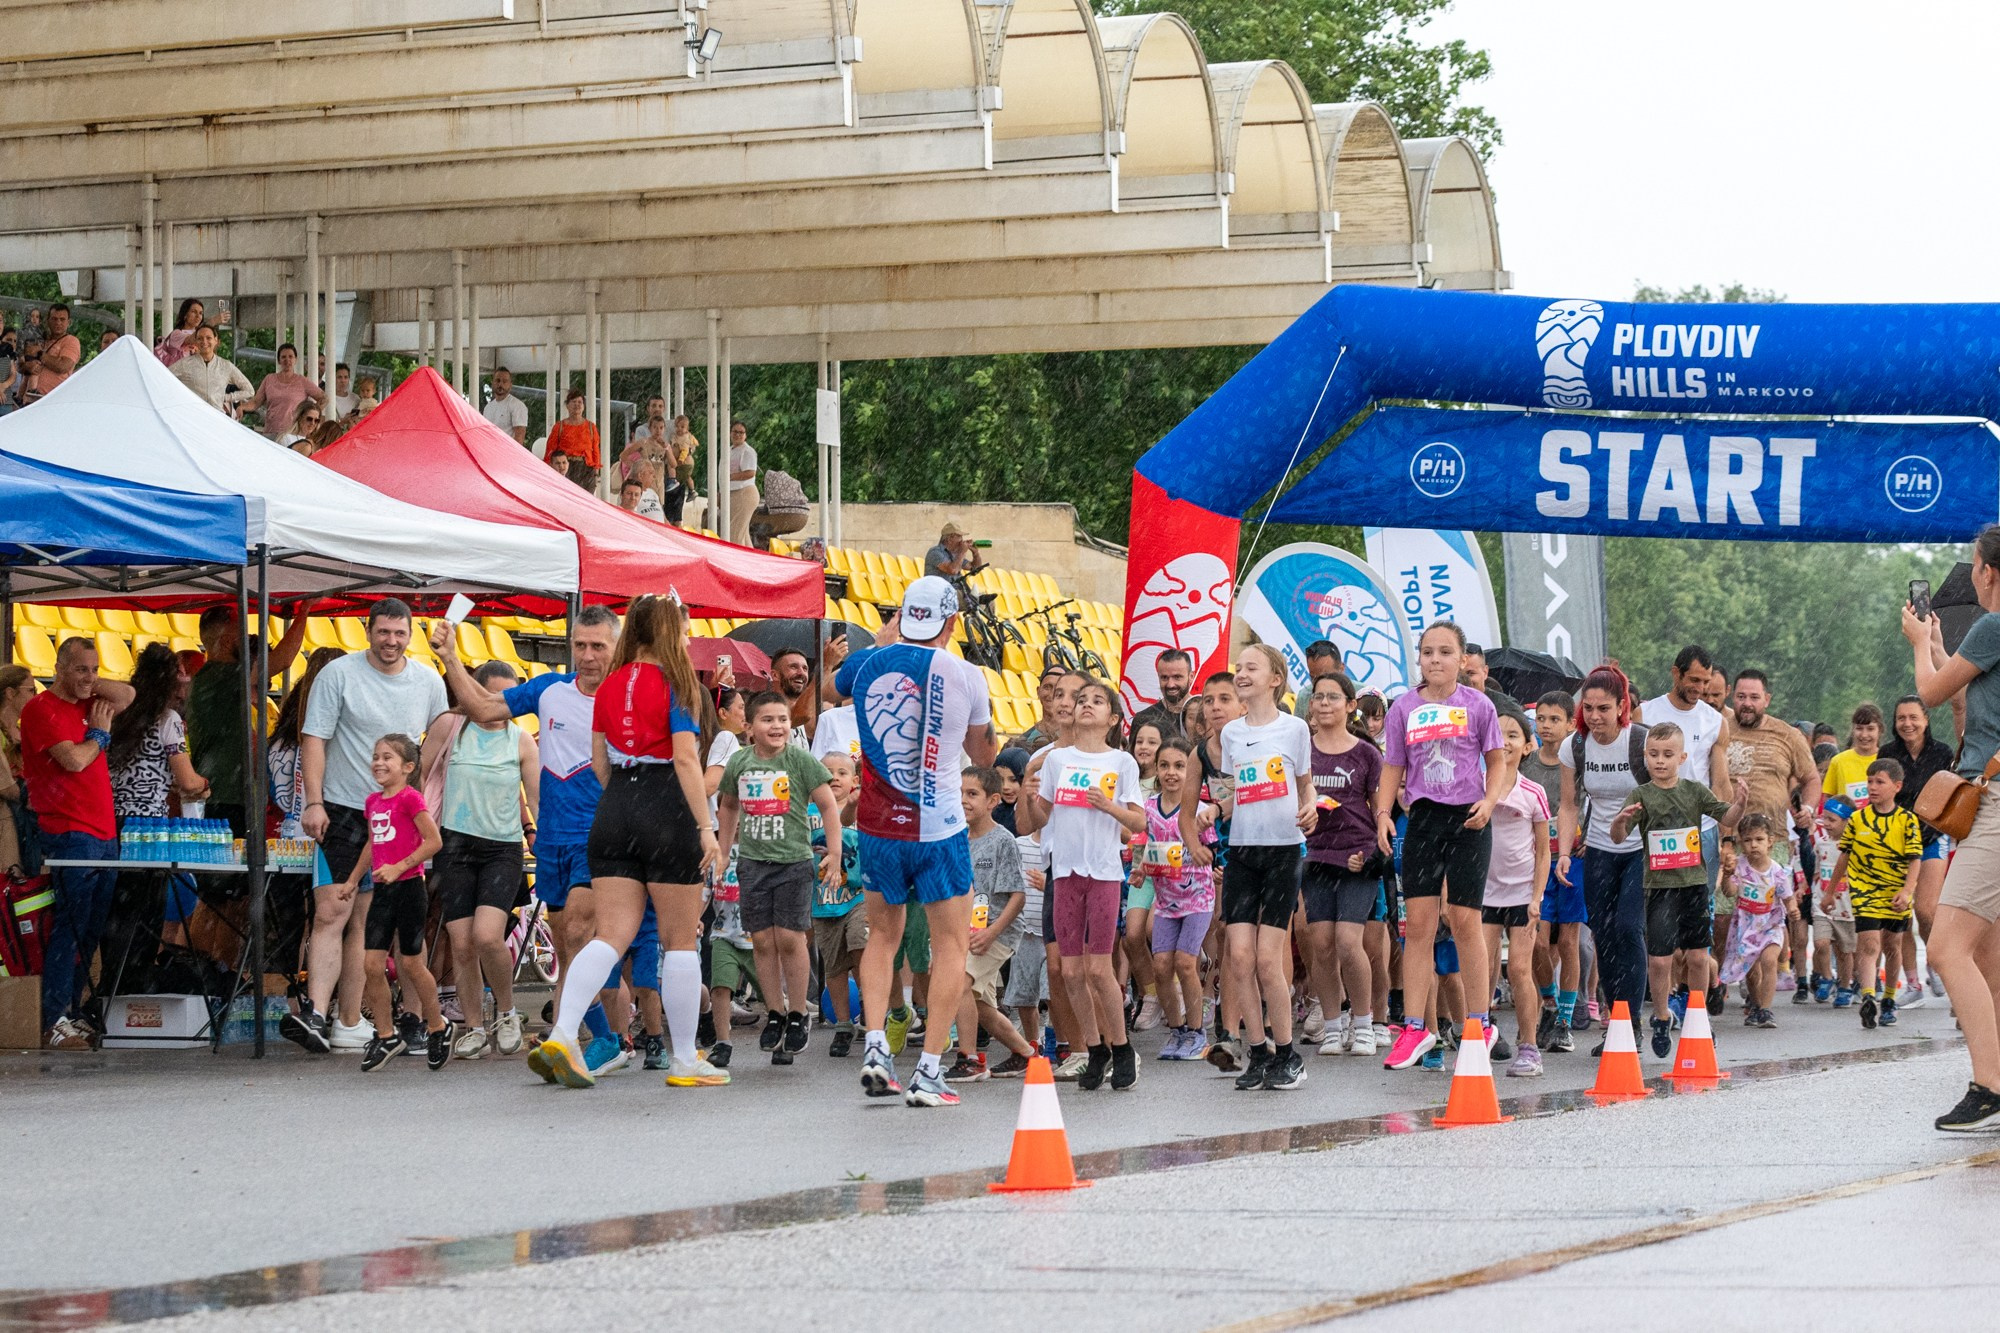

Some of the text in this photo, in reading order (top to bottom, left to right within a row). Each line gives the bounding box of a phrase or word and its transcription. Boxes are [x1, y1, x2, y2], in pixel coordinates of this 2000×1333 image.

[1613, 323, 1761, 358] PLOVDIV
[1612, 366, 1707, 398] HILLS
[1717, 372, 1736, 382] IN
[1718, 387, 1814, 397] MARKOVO
[1420, 459, 1455, 477] P/H
[1536, 429, 1817, 526] START
[1895, 473, 1932, 491] P/H
[1418, 710, 1438, 725] 97
[923, 673, 944, 808] EVERY STEP MATTERS
[295, 771, 303, 795] STEP
[1069, 772, 1091, 788] 46
[1239, 767, 1257, 783] 48
[1312, 775, 1346, 788] PUMA
[746, 783, 763, 797] 27
[292, 795, 302, 822] EVERY
[1659, 838, 1677, 851] 10
[1147, 850, 1159, 862] 11
[1744, 886, 1759, 900] 56
